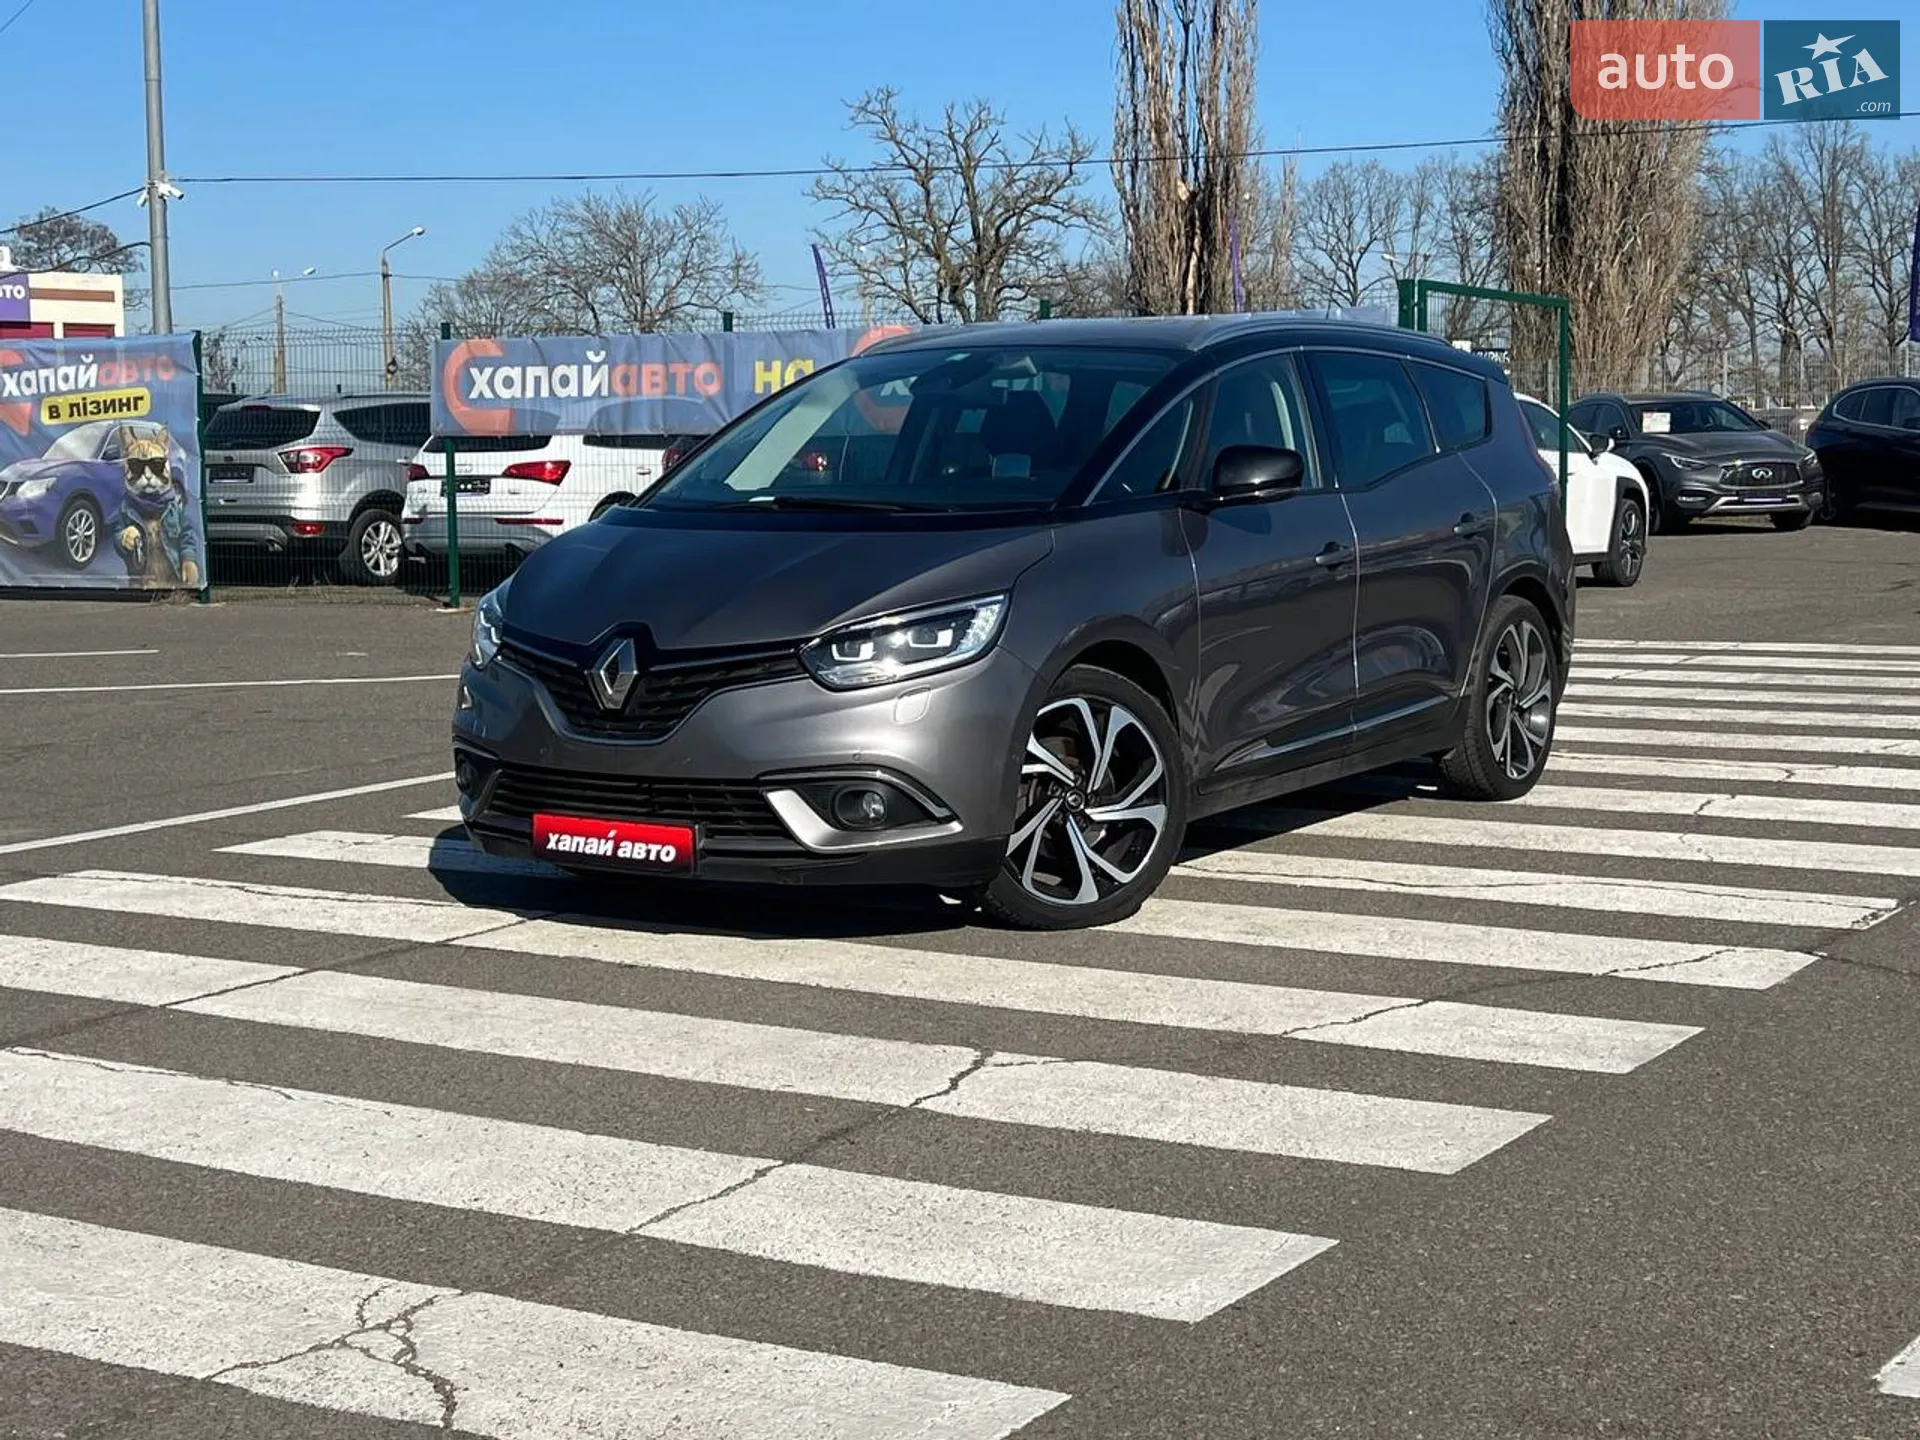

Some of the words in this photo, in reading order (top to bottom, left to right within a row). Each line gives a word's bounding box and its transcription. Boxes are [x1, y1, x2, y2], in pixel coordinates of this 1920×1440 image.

[48, 405, 61, 420] в
[68, 395, 144, 418] лізинг
[617, 840, 677, 863] авто
